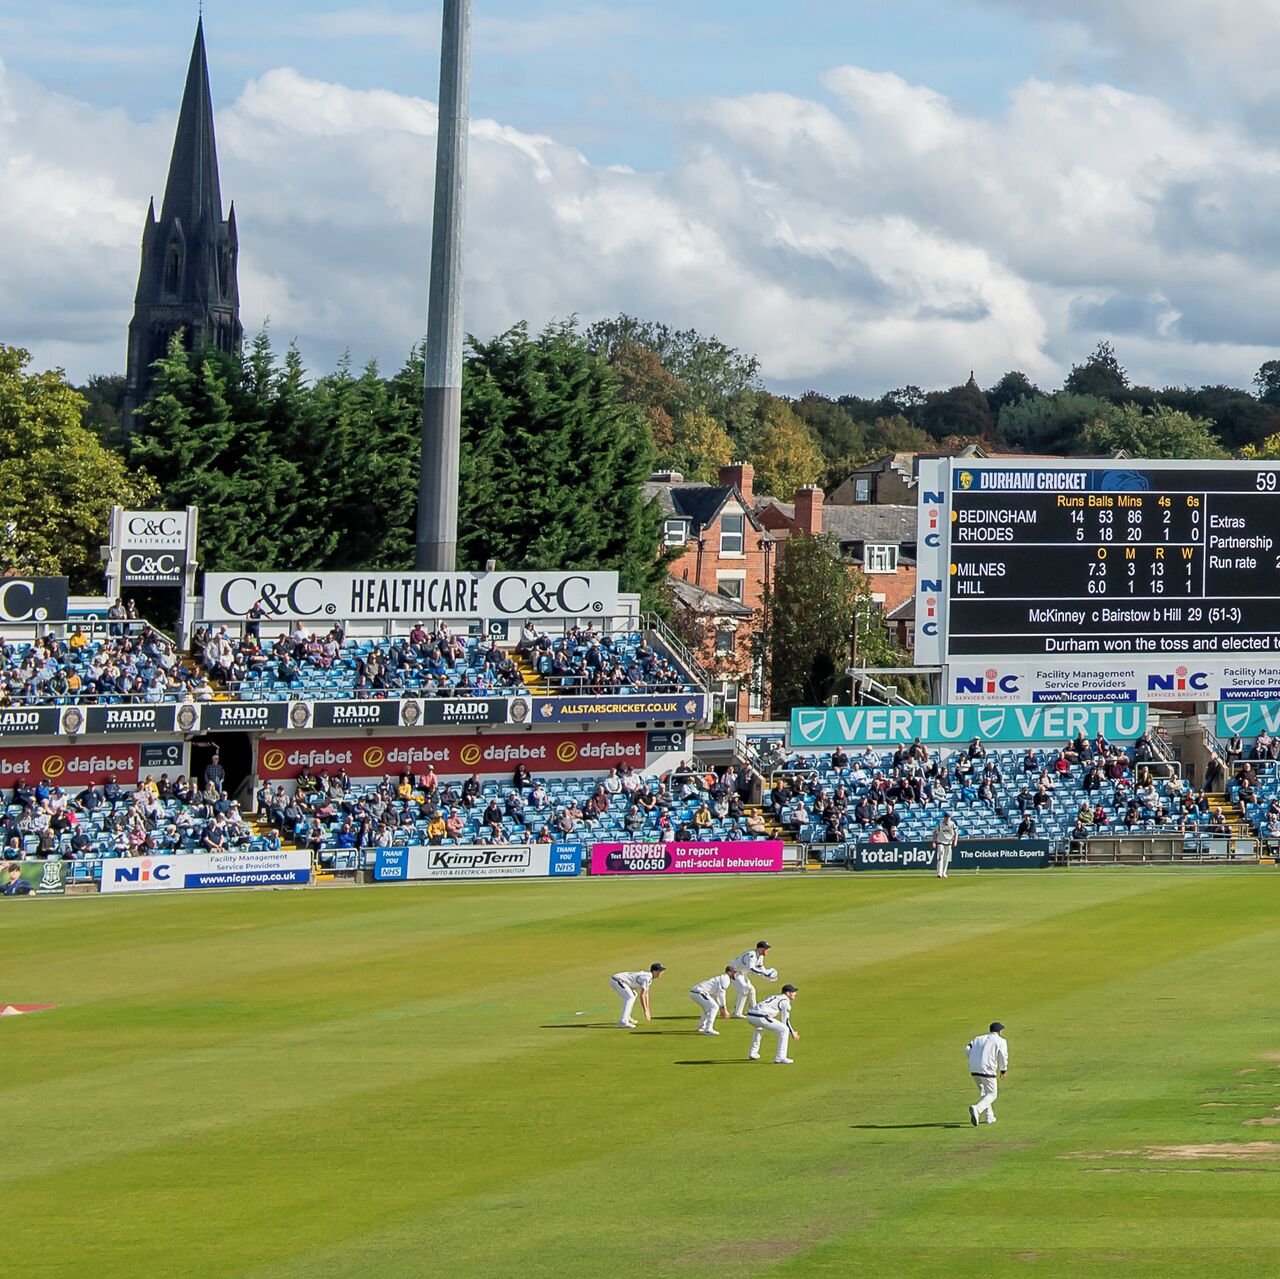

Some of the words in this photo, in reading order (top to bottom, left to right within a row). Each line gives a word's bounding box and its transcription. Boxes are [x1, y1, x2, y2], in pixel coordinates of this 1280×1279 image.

[981, 473, 1034, 489] DURHAM
[1037, 473, 1087, 489] CRICKET
[1256, 473, 1276, 491] 59
[1058, 495, 1084, 506] Runs
[1089, 495, 1113, 506] Balls
[1118, 496, 1142, 506] Mins
[1158, 496, 1170, 506] 4s
[1187, 496, 1199, 506] 6s
[959, 510, 1036, 523] BEDINGHAM
[1071, 510, 1084, 523] 14
[1099, 510, 1113, 523] 53
[1128, 510, 1142, 523] 86
[1163, 510, 1170, 523] 2
[1192, 510, 1199, 523] 0
[1210, 515, 1245, 528] Extras
[959, 527, 1013, 541] RHODES
[1076, 528, 1084, 541] 5
[1099, 528, 1113, 541] 18
[1127, 528, 1142, 541] 20
[1164, 528, 1169, 540] 1
[1192, 528, 1199, 541] 0
[1210, 535, 1273, 551] Partnership
[1098, 548, 1106, 559] O
[1126, 548, 1135, 559] M
[1156, 548, 1164, 559] R
[1182, 548, 1193, 559] W
[1210, 556, 1232, 568] Run
[1235, 556, 1256, 568] rate
[958, 563, 1005, 576] MILNES
[1089, 563, 1106, 576] 7.3
[1128, 562, 1135, 576] 3
[1151, 562, 1164, 576] 13
[1186, 562, 1191, 575] 1
[957, 581, 985, 594] HILL
[1088, 580, 1106, 593] 6.0
[1128, 580, 1133, 593] 1
[1150, 580, 1163, 593] 15
[1186, 580, 1191, 593] 1
[351, 578, 478, 612] HEALTHCARE
[1029, 609, 1085, 625] McKinney
[1092, 611, 1099, 622] c
[1102, 608, 1150, 621] Bairstow
[1153, 608, 1161, 621] b
[1164, 608, 1181, 621] Hill
[1188, 608, 1202, 621] 29
[1208, 608, 1241, 624] (51-3)
[1045, 637, 1099, 651] Durham
[1104, 640, 1131, 650] won
[1135, 637, 1157, 650] the
[1160, 638, 1188, 649] toss
[1193, 637, 1217, 649] and
[1222, 636, 1269, 649] elected
[1037, 670, 1070, 680] Facility
[1073, 671, 1134, 679] Management
[1224, 668, 1256, 677] Facility
[1045, 680, 1079, 689] Service
[1082, 680, 1127, 689] Providers
[1232, 677, 1265, 686] Service
[221, 708, 268, 719] RADO
[443, 703, 488, 714] RADO
[561, 703, 677, 714] ALLSTARSCRICKET.CO.UK
[836, 709, 964, 740] VERTU
[1015, 705, 1140, 736] VERTU
[387, 747, 449, 764] dafabet
[580, 742, 641, 759] dafabet
[67, 756, 134, 774] dafabet
[623, 844, 668, 860] RESPECT
[676, 847, 686, 856] to
[689, 847, 718, 857] report
[861, 847, 935, 865] total-play
[975, 850, 999, 858] Cricket
[1019, 850, 1044, 858] Experts
[209, 856, 239, 865] Facility
[240, 853, 288, 863] Management
[432, 851, 525, 869] KrimpTerm
[630, 859, 664, 869] 60650
[675, 858, 724, 868] anti-social
[727, 858, 774, 867] behaviour
[249, 862, 280, 871] Providers
[381, 867, 401, 876] NHS
[555, 863, 575, 872] NHS
[200, 872, 296, 884] www.nicgroup.co.uk
